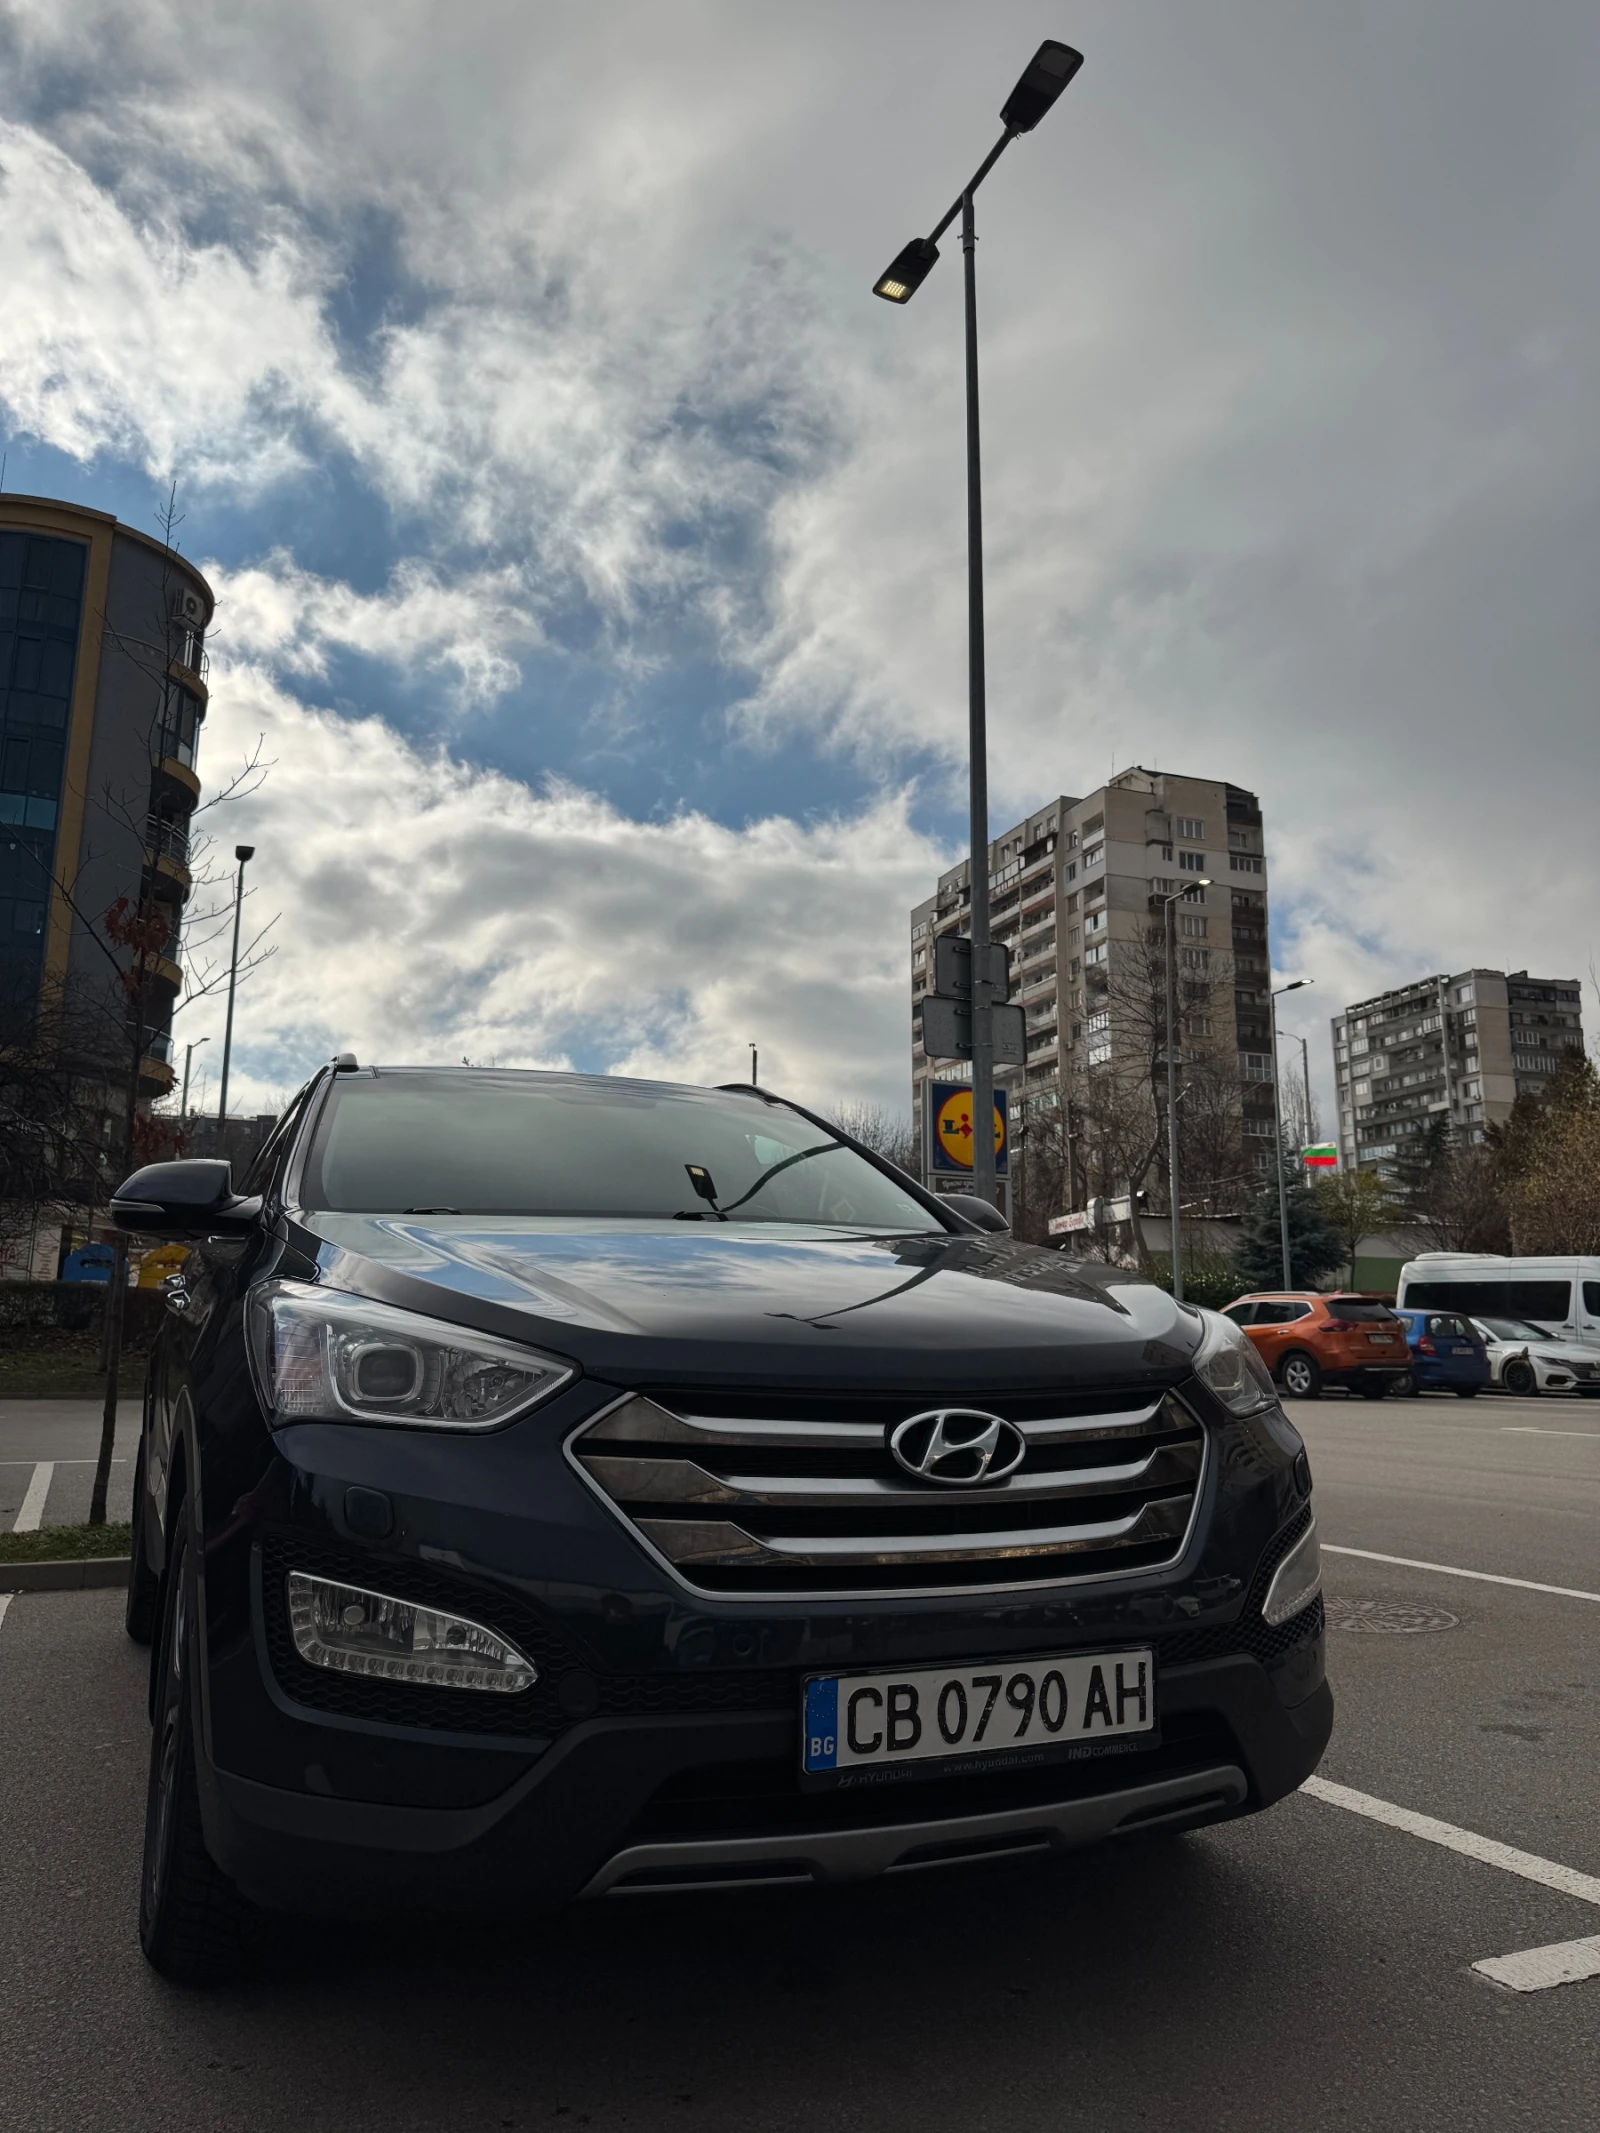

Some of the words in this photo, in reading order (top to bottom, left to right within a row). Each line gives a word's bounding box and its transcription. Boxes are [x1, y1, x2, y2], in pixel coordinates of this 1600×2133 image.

[847, 1684, 921, 1754] CB
[938, 1670, 1067, 1744] 0790
[1083, 1661, 1145, 1728] AH
[810, 1736, 835, 1757] BG
